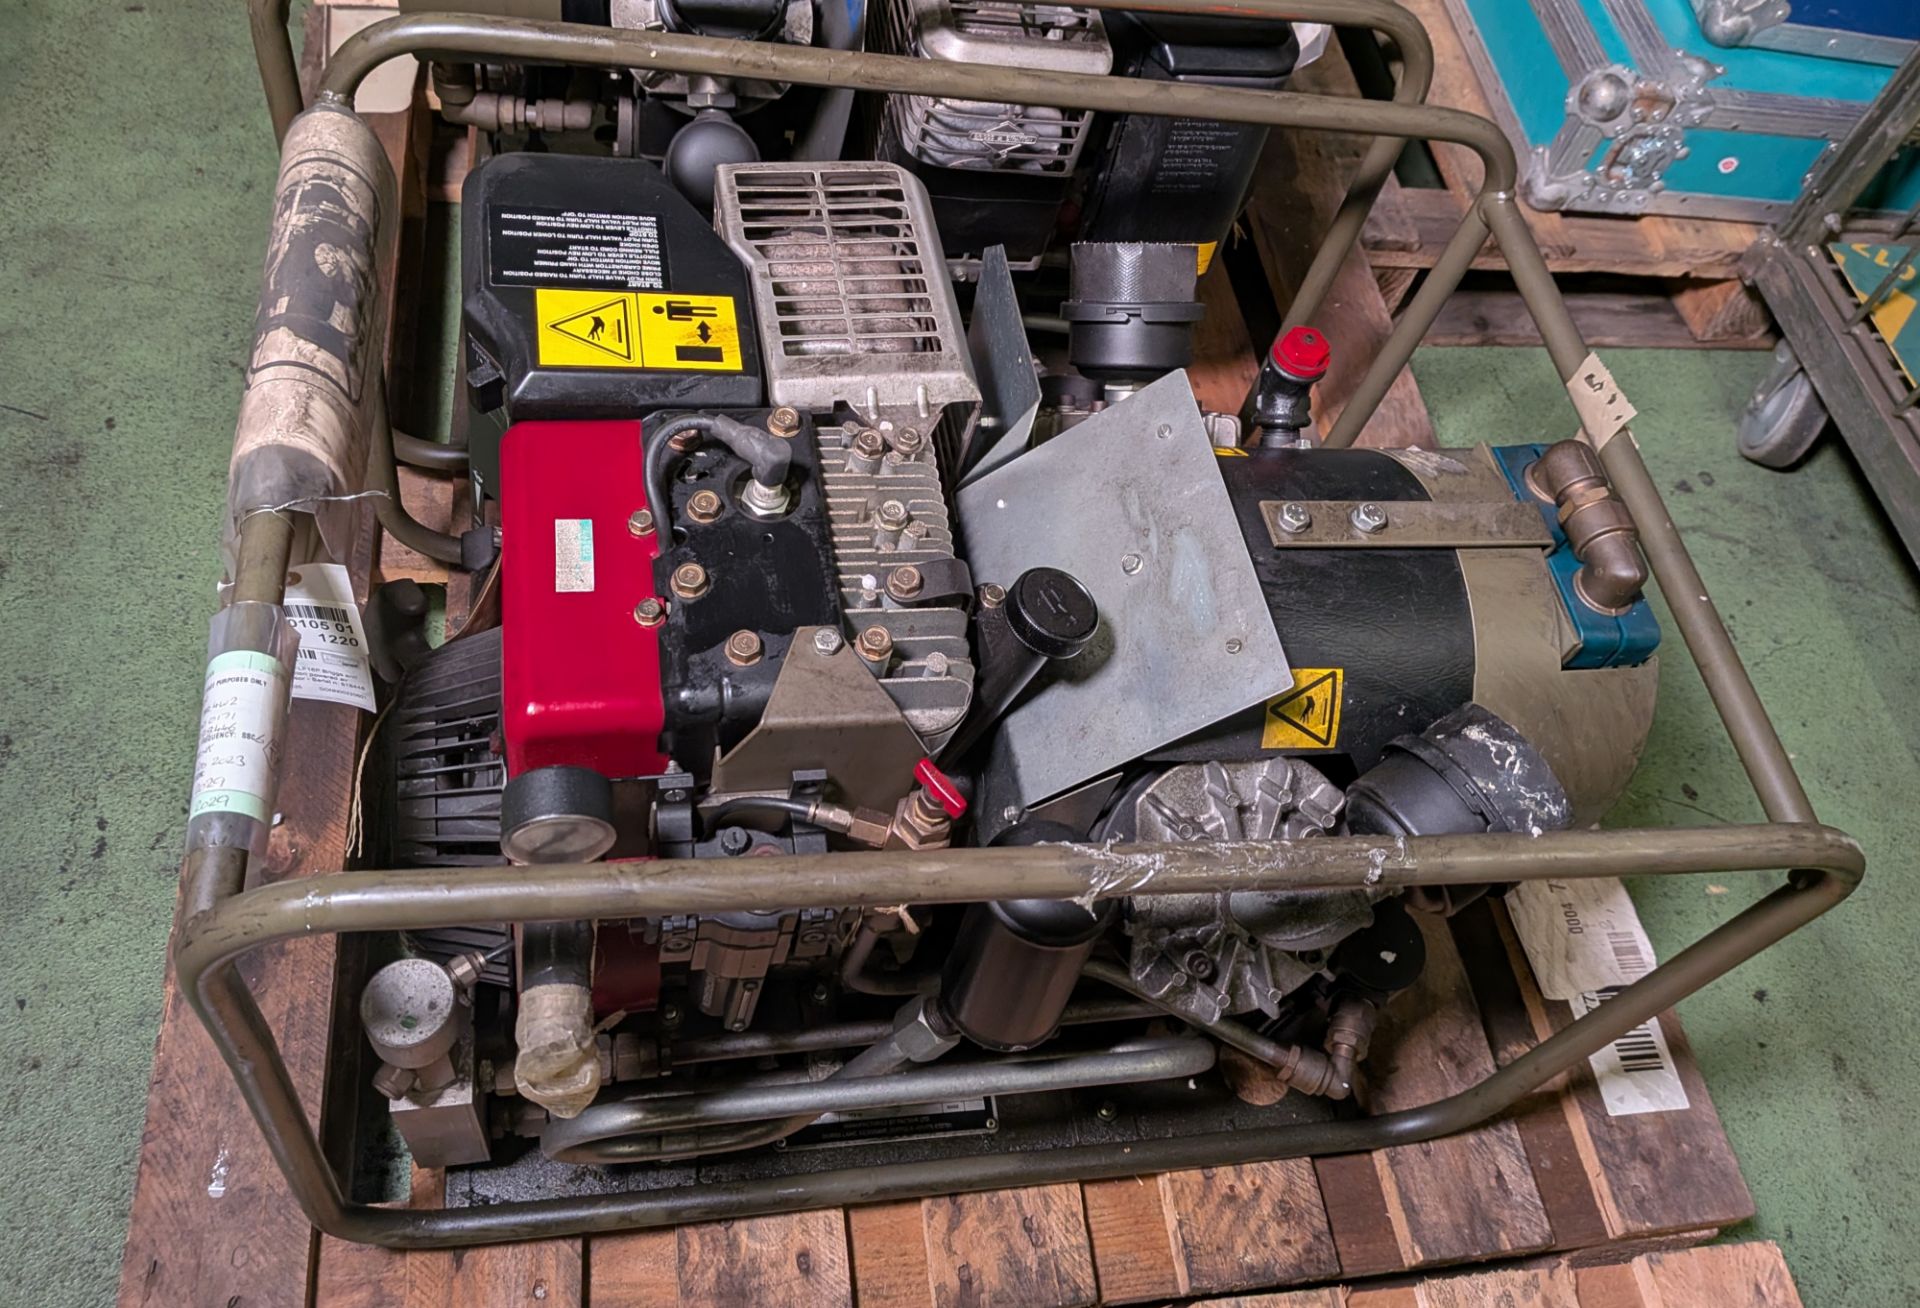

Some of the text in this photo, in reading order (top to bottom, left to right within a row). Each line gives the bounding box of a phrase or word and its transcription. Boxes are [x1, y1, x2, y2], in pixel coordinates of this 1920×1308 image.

[628, 280, 650, 288] START
[335, 623, 354, 634] 01
[318, 633, 359, 647] 1220
[250, 678, 267, 687] ONLY
